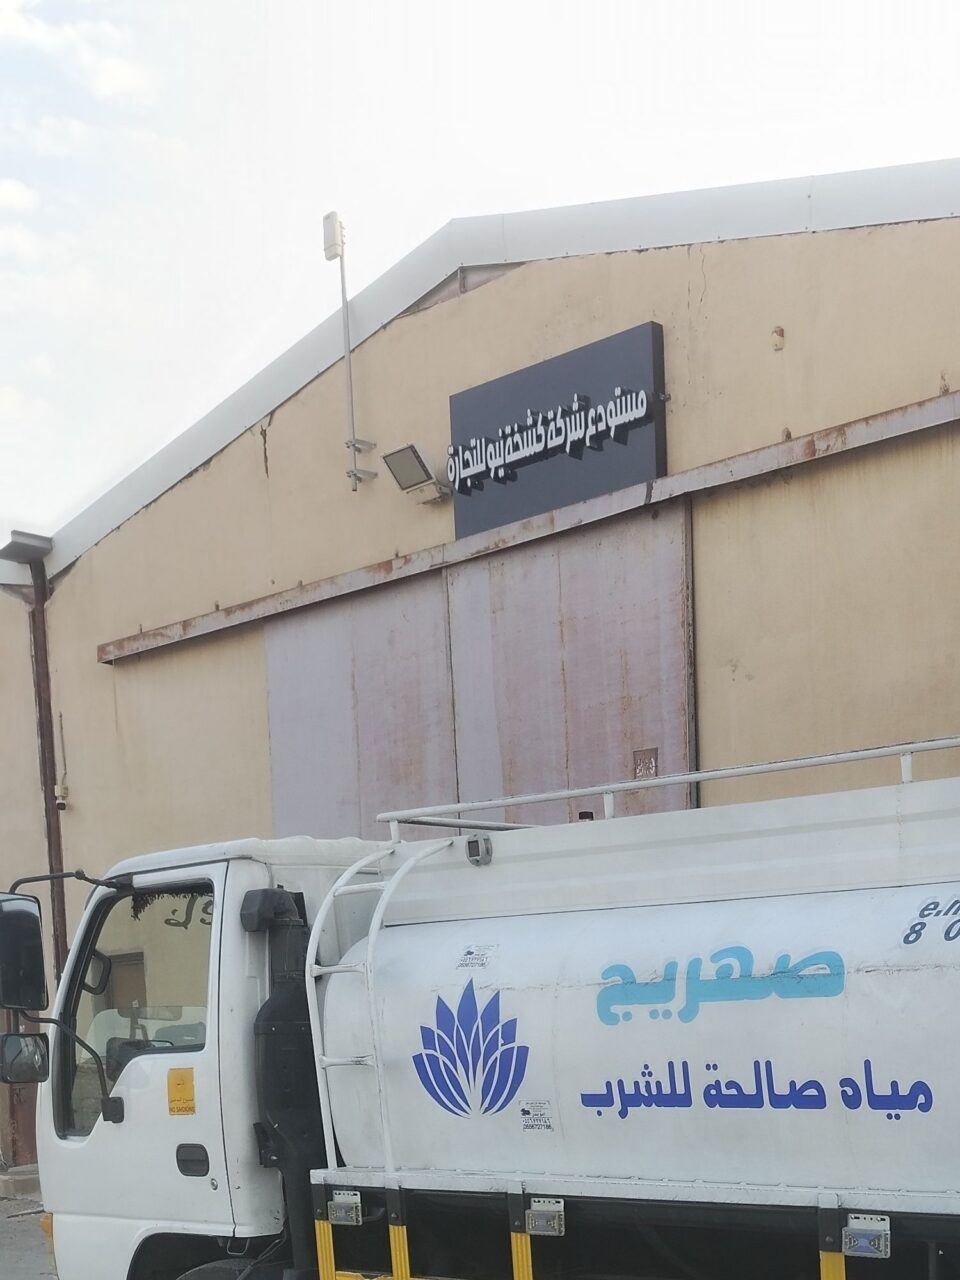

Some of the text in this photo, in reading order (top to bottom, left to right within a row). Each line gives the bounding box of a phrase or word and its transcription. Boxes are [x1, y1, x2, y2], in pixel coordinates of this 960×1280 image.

[505, 408, 546, 464] كشخة
[547, 393, 586, 454] شركة
[586, 387, 647, 447] مستودع
[447, 437, 487, 491] للتجارة
[903, 921, 927, 945] 8
[597, 946, 845, 1025] صهريج
[580, 1059, 933, 1120] مياه صالحة للشرب
